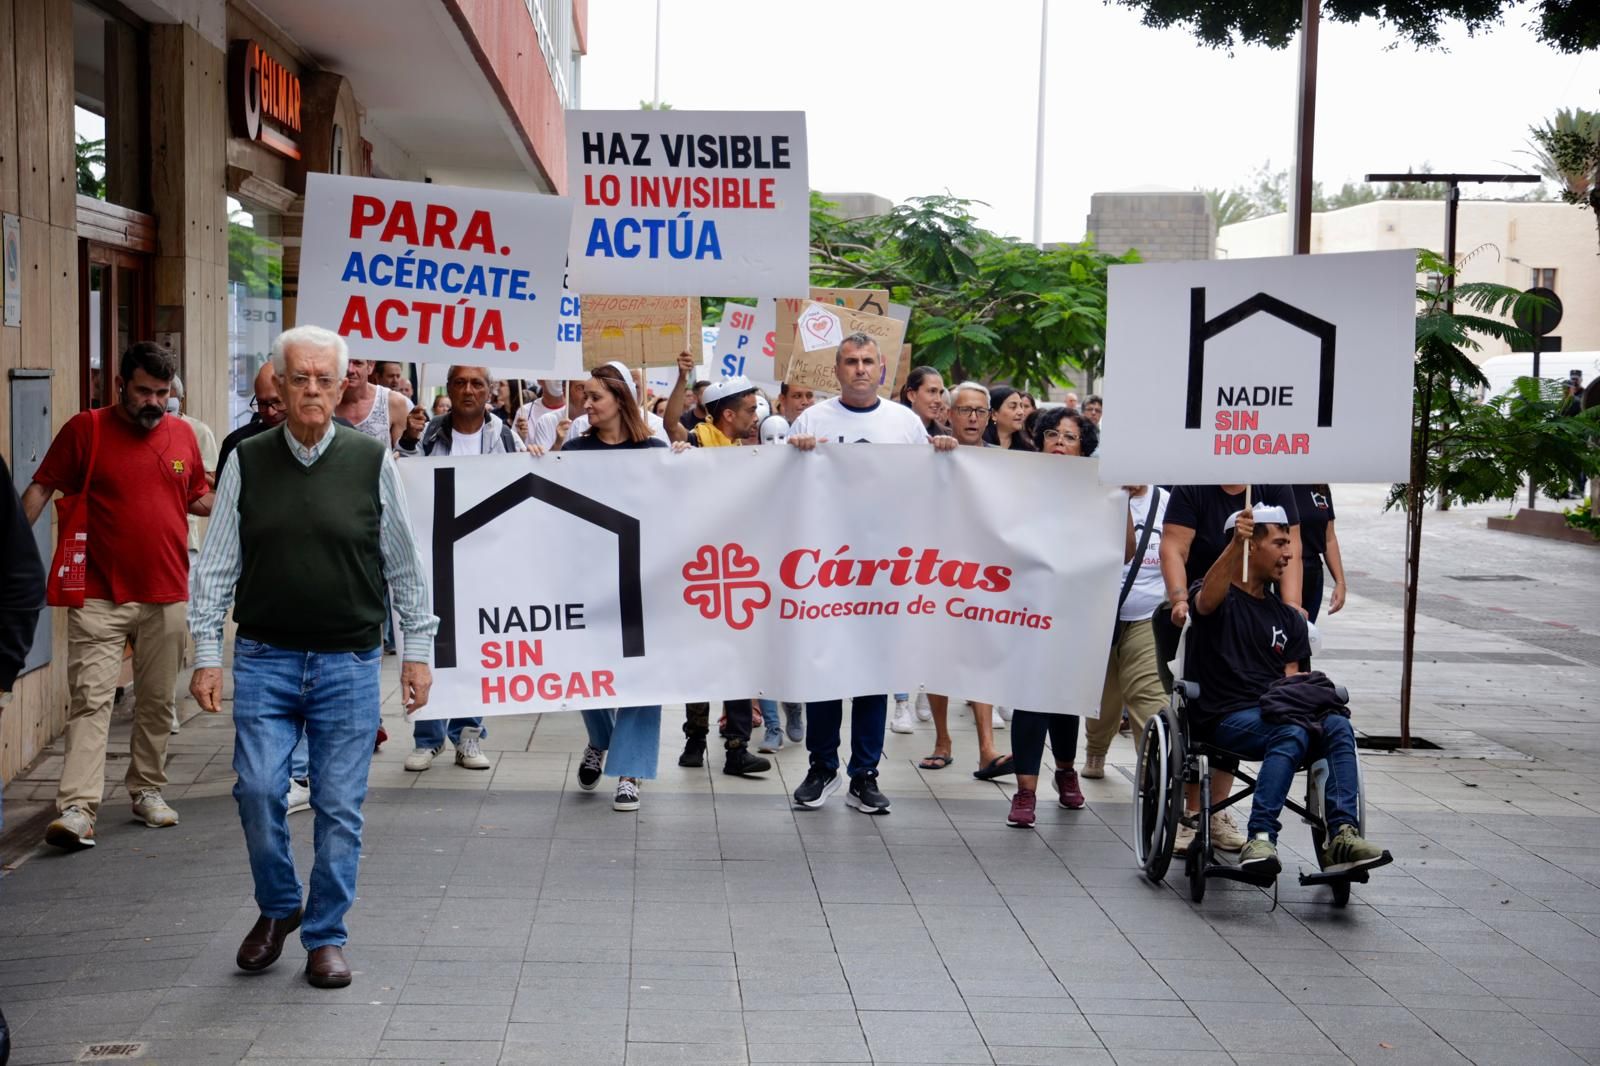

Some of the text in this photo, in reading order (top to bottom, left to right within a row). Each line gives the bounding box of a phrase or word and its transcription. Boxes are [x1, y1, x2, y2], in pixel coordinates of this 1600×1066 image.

[261, 50, 301, 132] GILMAR
[583, 132, 790, 168] HAZ VISIBLE
[585, 175, 775, 208] LO INVISIBLE
[350, 195, 511, 256] PARA.
[586, 211, 722, 261] ACTÚA
[342, 248, 536, 301] ACÉRCATE.
[339, 297, 519, 351] ACTÚA.
[1217, 387, 1294, 406] NADIE
[1215, 410, 1259, 430] SIN
[1214, 434, 1310, 455] HOGAR
[779, 545, 1012, 593] Cáritas
[479, 604, 586, 634] NADIE
[780, 595, 1052, 630] Diocesana de Canarias
[482, 640, 544, 669] SIN
[482, 671, 615, 704] HOGAR
